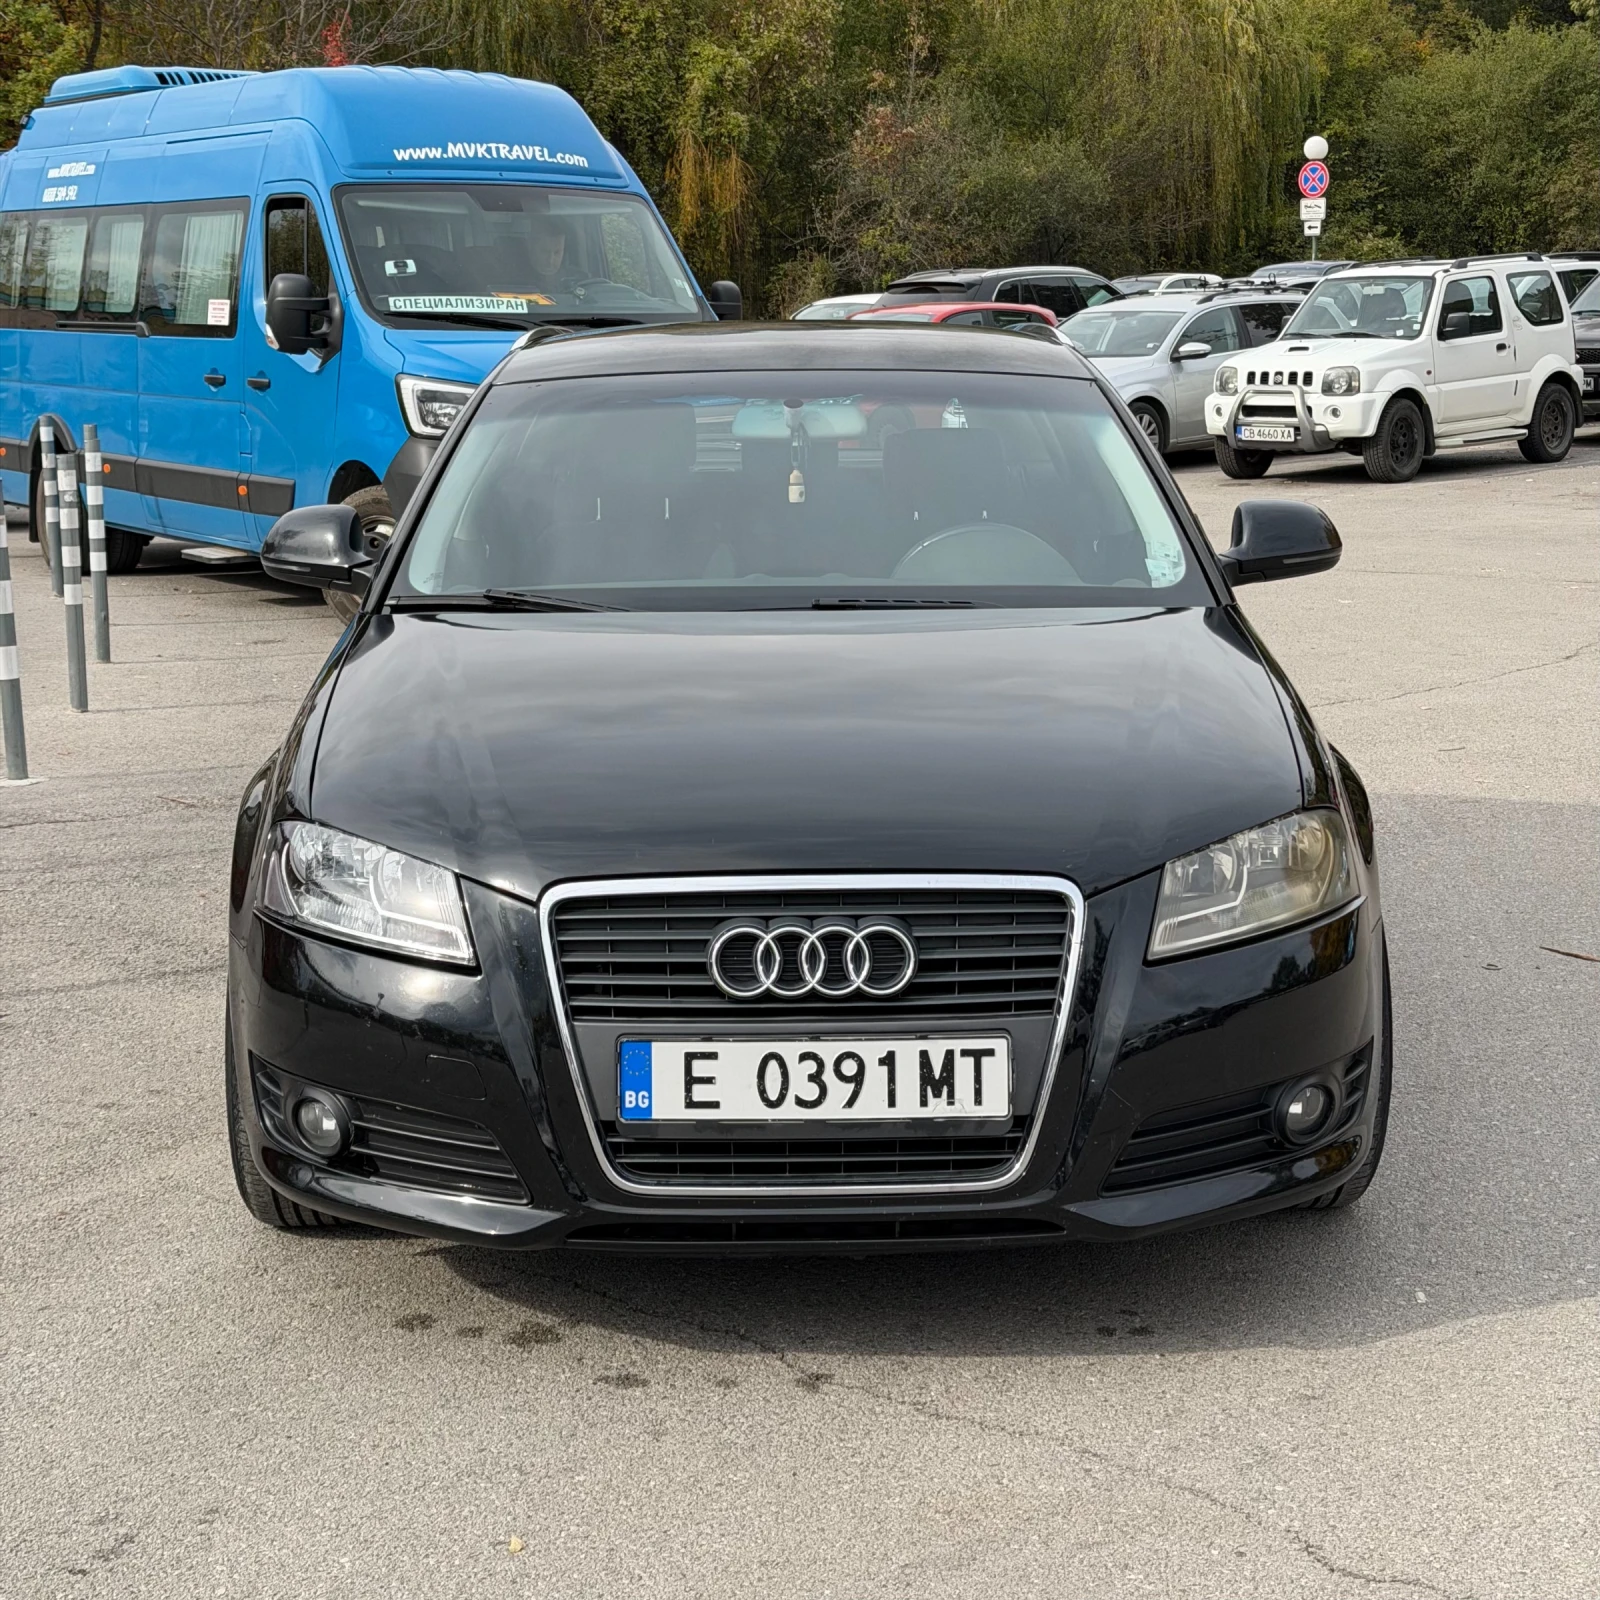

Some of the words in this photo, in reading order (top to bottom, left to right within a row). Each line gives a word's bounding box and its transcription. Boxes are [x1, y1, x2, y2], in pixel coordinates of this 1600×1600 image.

[393, 142, 589, 168] www.MVKTRAVEL.com
[393, 297, 525, 311] СПЕЦИАЛИЗИРАН
[1243, 428, 1255, 439] CB
[1257, 428, 1278, 439] 4660
[1280, 429, 1292, 439] XA
[684, 1051, 721, 1109] E
[756, 1051, 897, 1110] 0391
[918, 1049, 996, 1107] MT
[625, 1090, 649, 1108] BG
